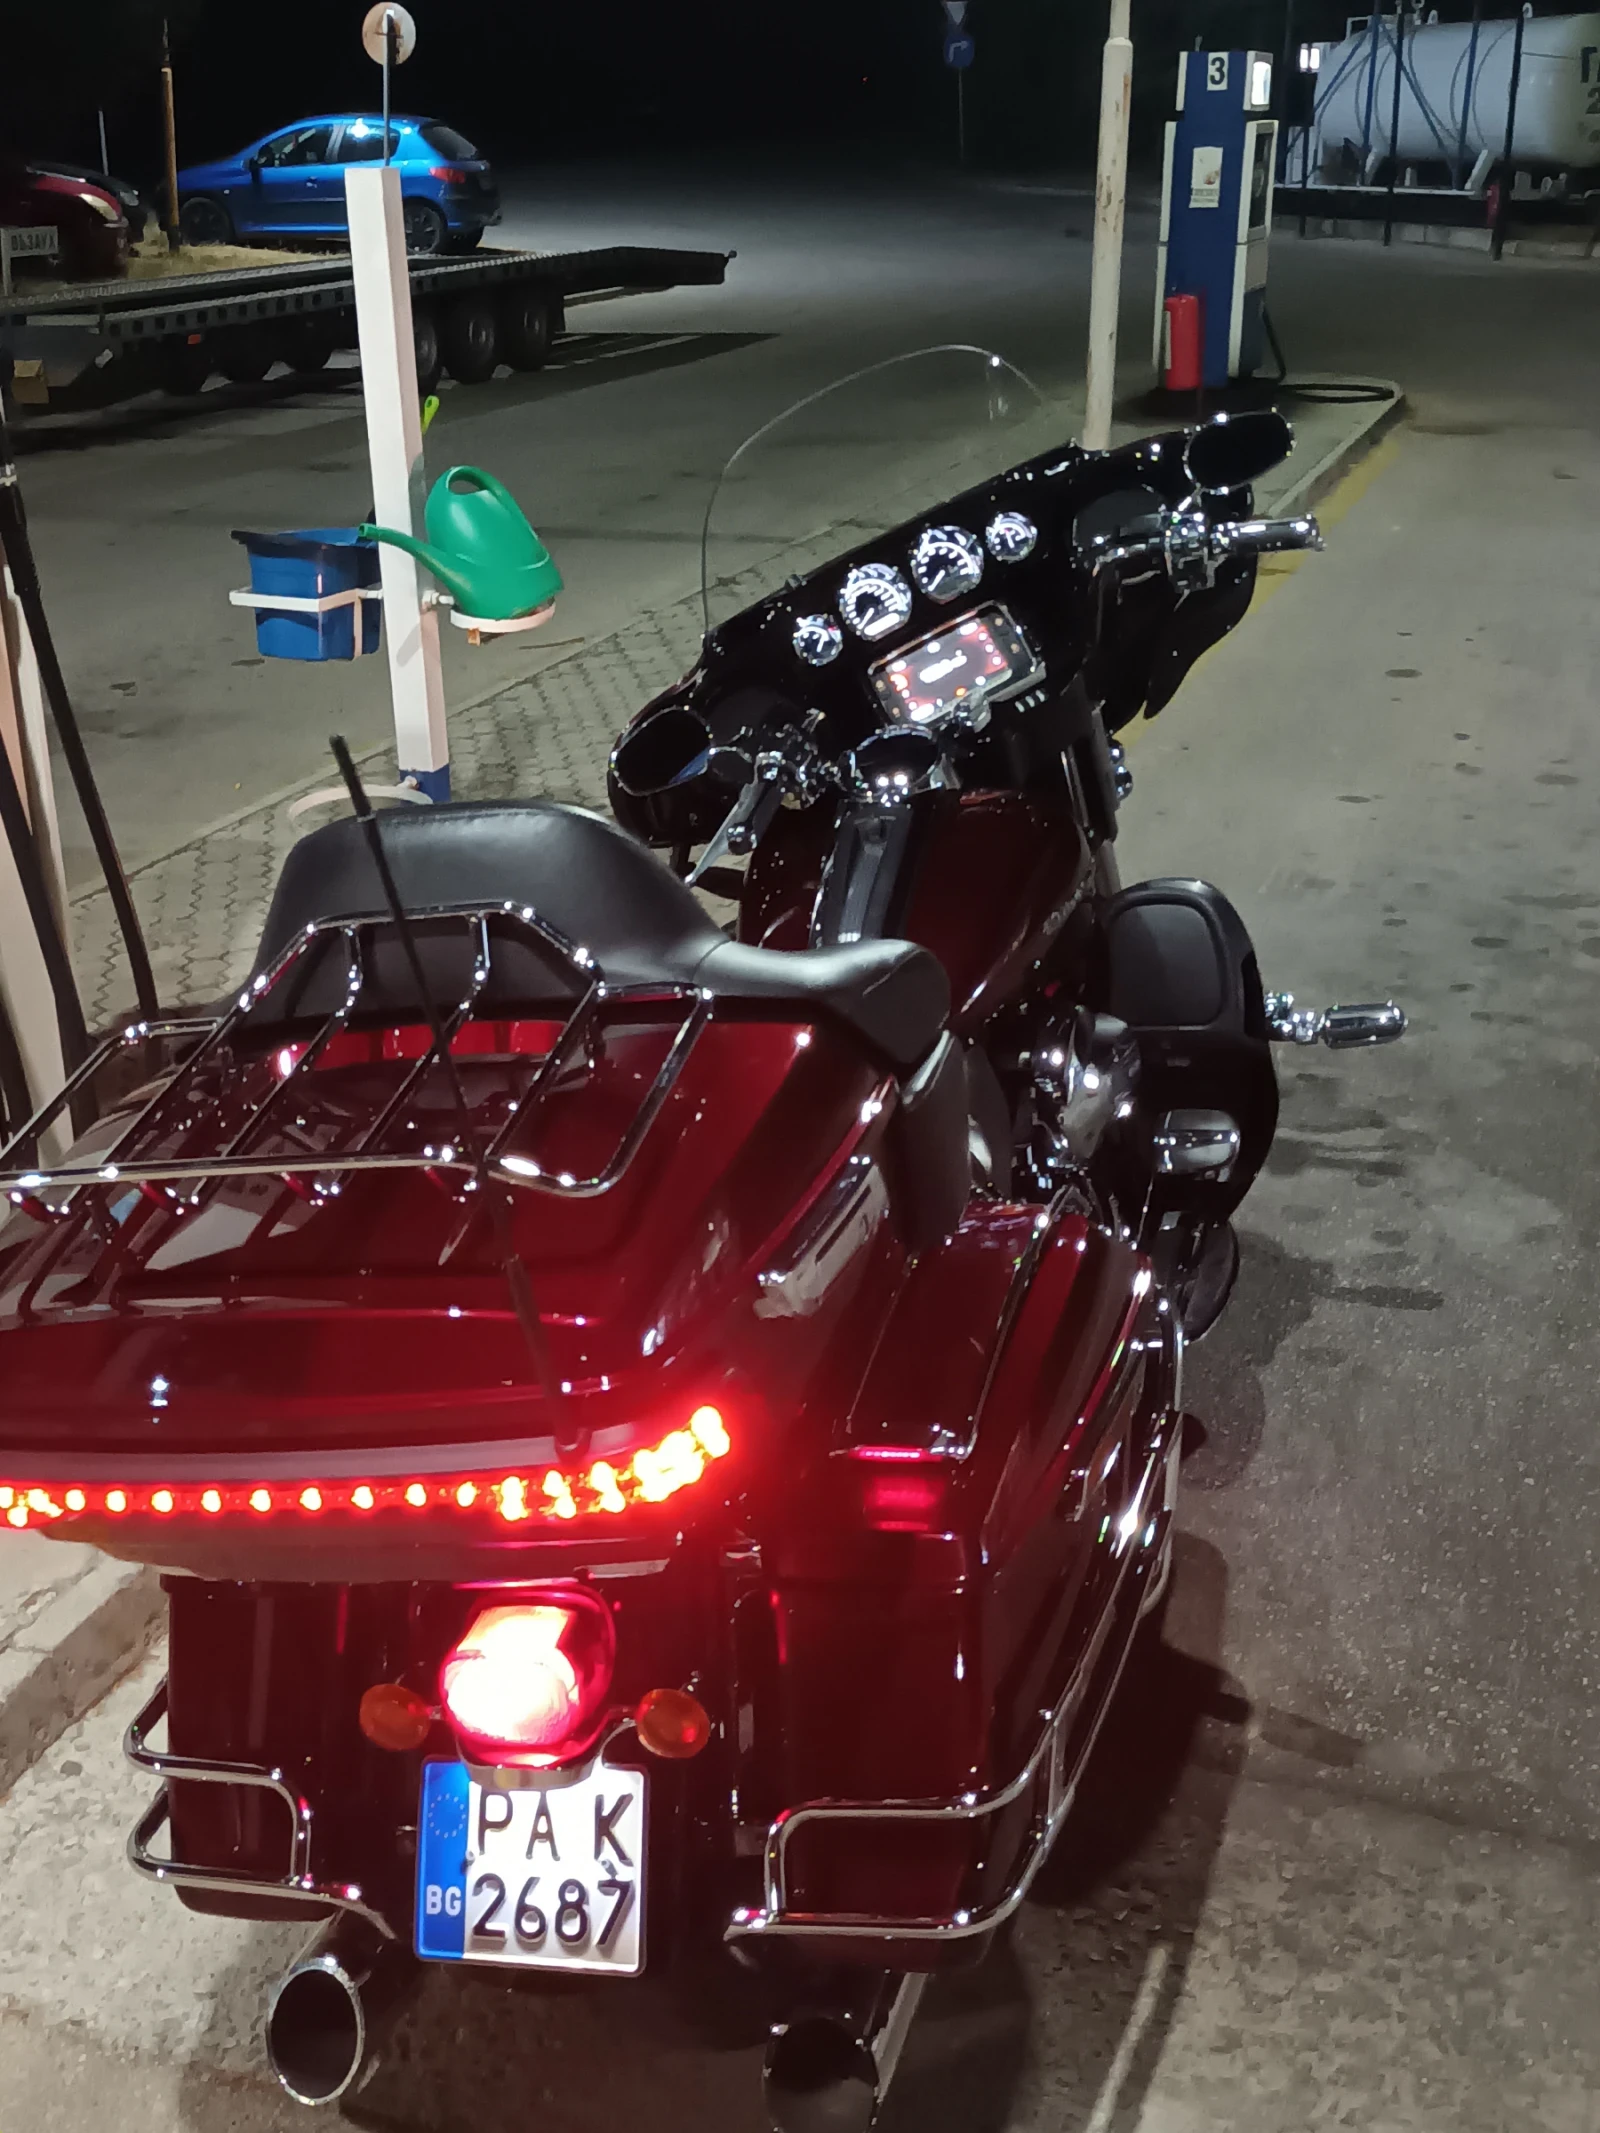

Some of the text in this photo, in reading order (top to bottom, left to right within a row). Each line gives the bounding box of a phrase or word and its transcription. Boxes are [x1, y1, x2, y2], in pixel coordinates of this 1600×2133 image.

[1209, 57, 1226, 85] 3
[426, 1885, 462, 1916] BG
[472, 1873, 636, 1950] 2687
